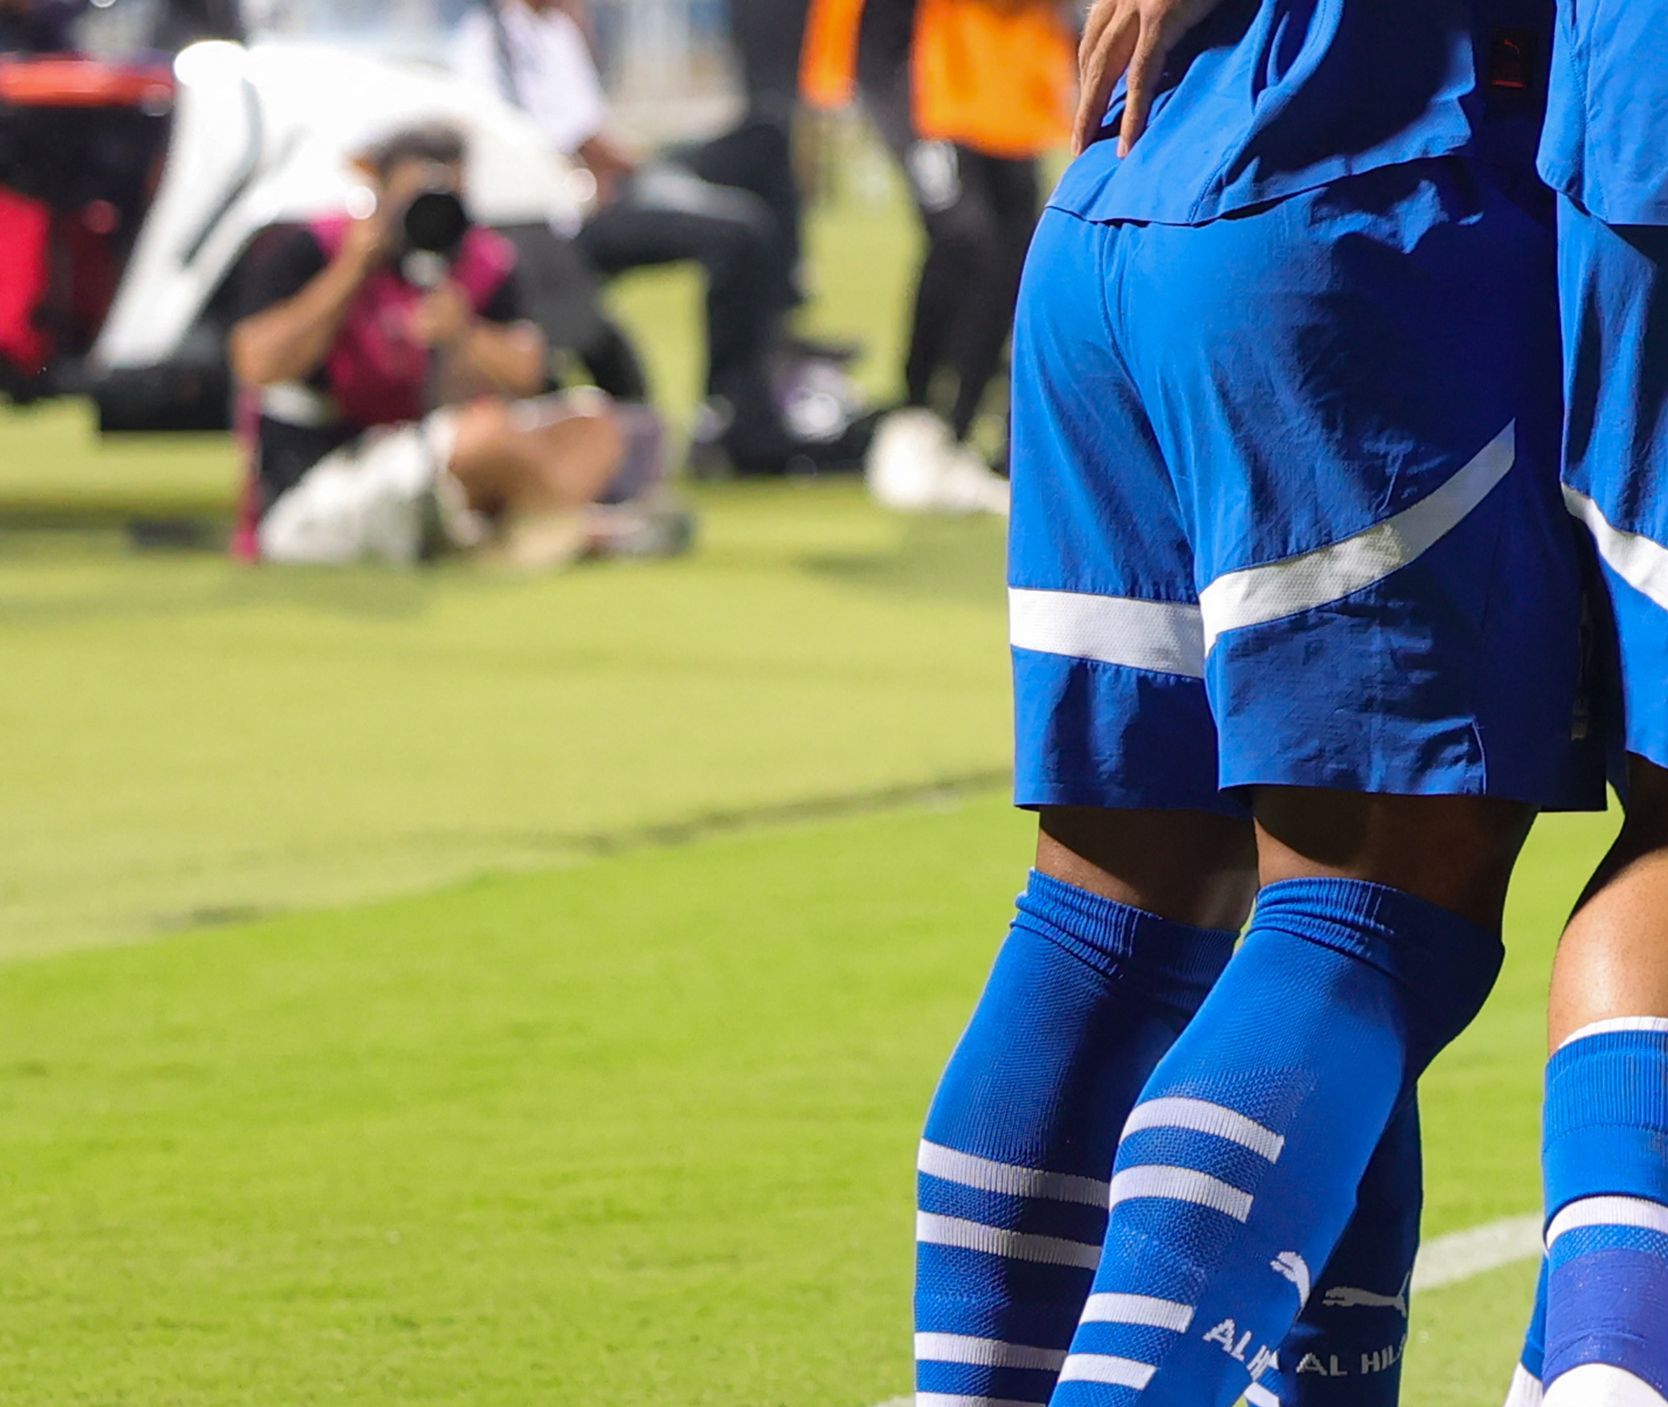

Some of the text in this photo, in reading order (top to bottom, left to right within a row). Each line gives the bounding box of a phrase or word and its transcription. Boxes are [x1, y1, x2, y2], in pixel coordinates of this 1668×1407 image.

[1202, 1318, 1251, 1361] AL
[1296, 1352, 1347, 1376] AL
[1361, 1342, 1405, 1374] HIL
